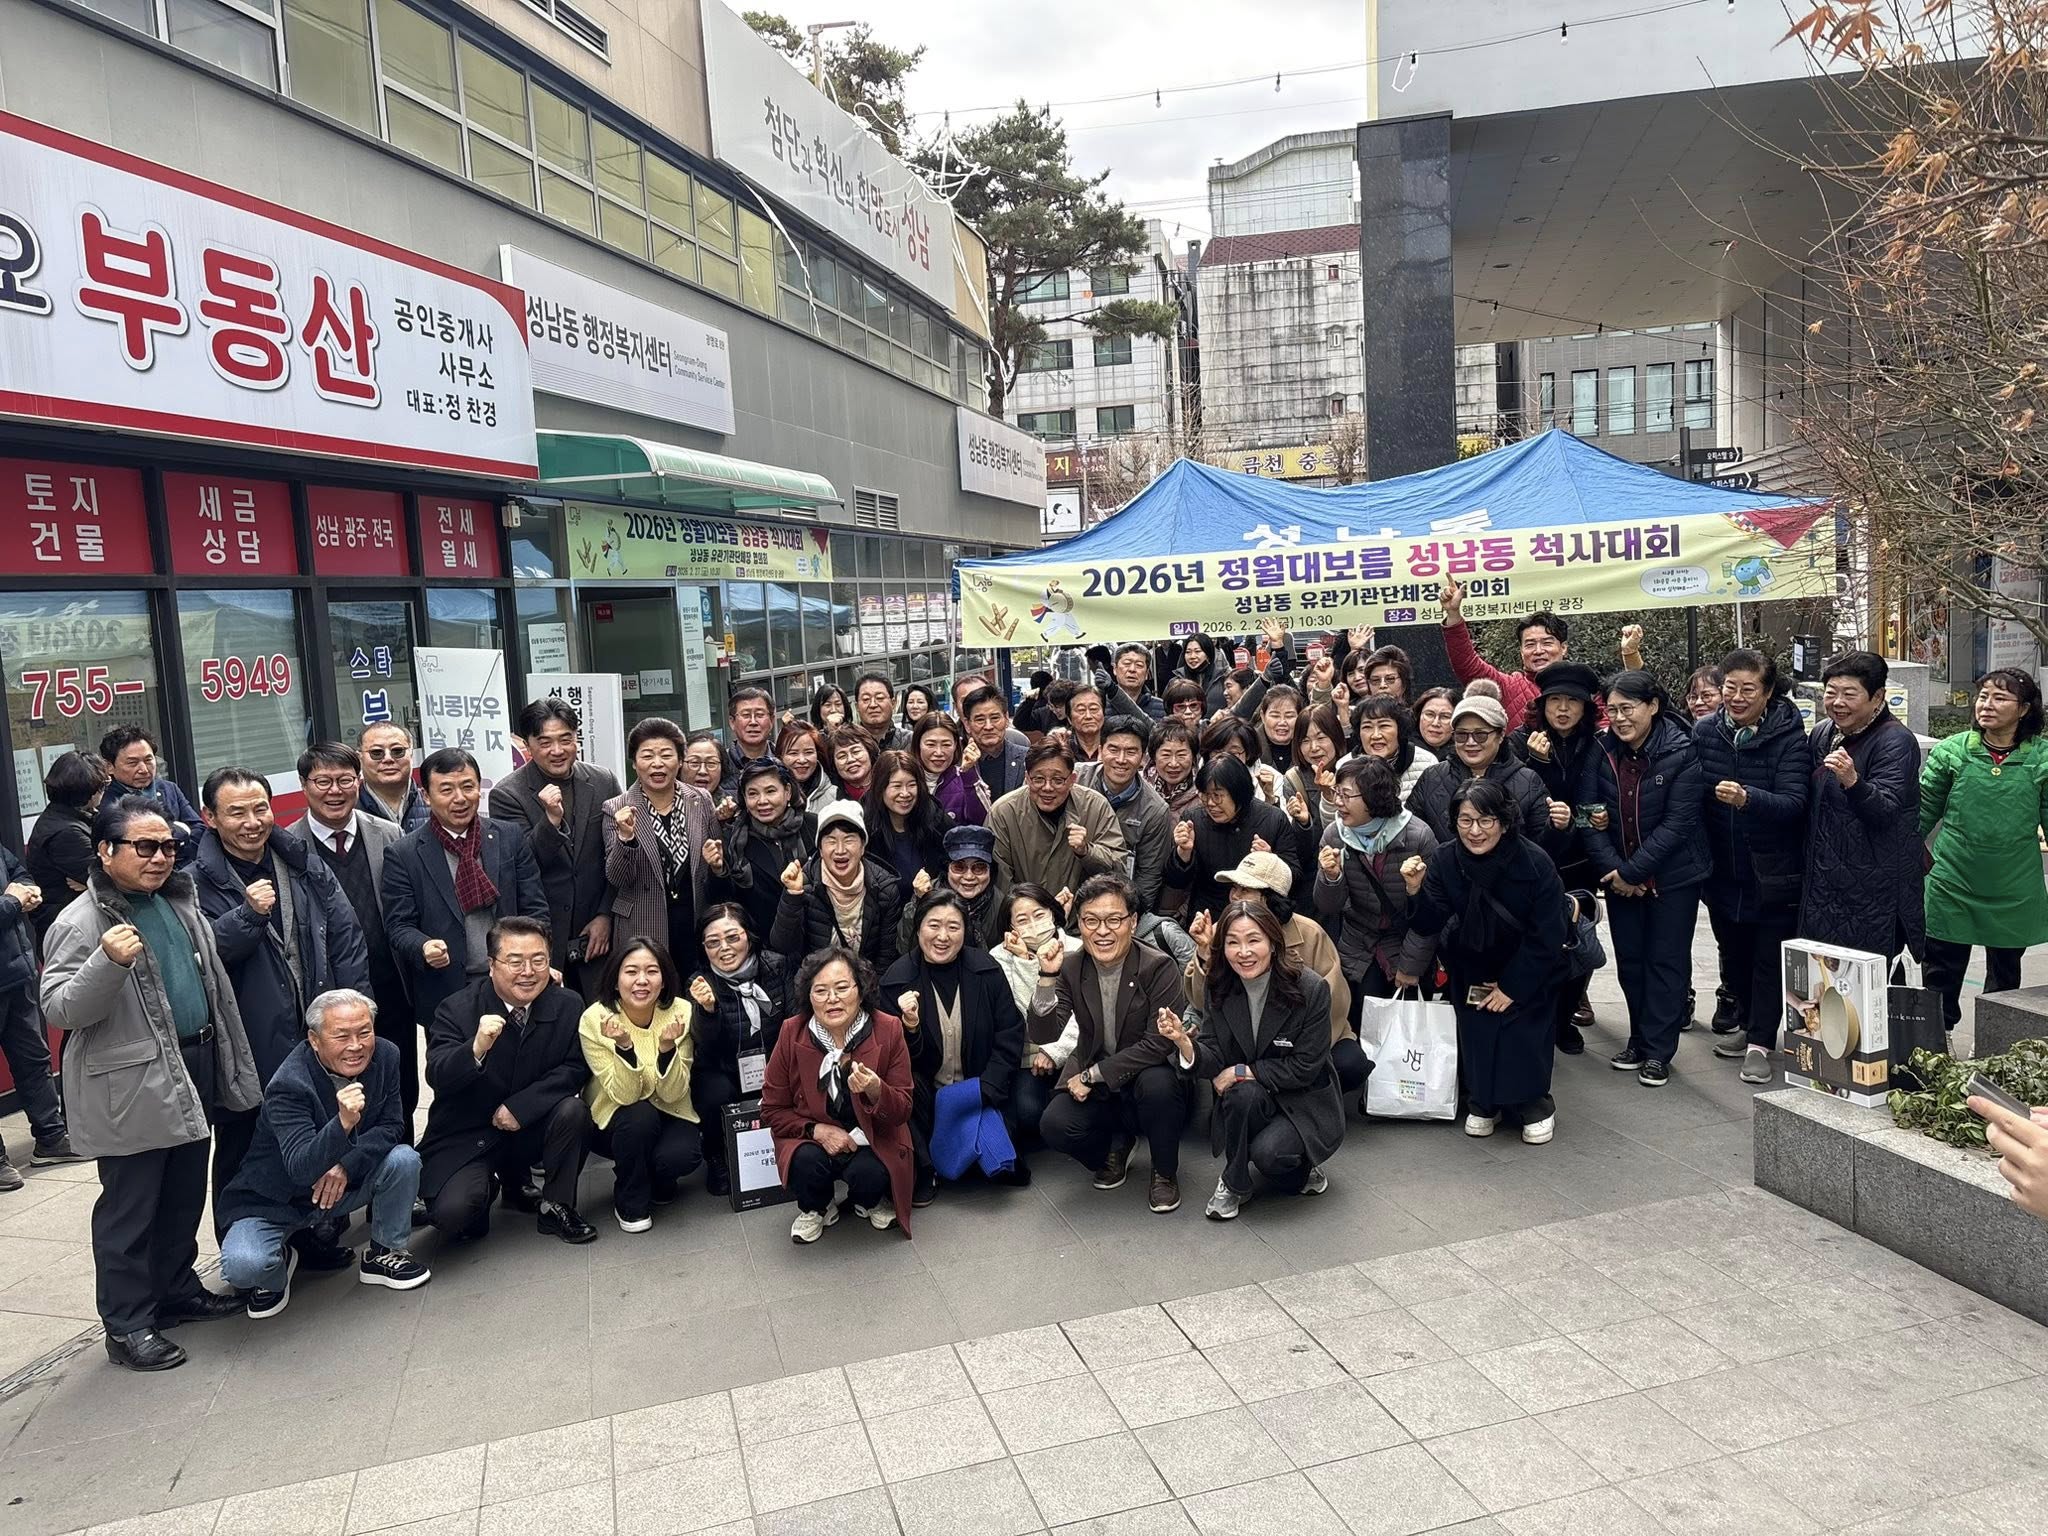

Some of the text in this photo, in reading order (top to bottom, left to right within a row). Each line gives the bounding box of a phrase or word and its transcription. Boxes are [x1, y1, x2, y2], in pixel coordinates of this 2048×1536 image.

[763, 96, 930, 272] 첨단과 혁신의 희망도시 성남
[75, 207, 380, 405] 부동산
[393, 297, 494, 355] 공인중개사
[526, 296, 673, 378] 성남동 행정복지센터
[439, 351, 495, 390] 사무소
[968, 432, 1023, 478] 성남동 행정복지센터
[623, 511, 803, 550] 2026년 정월대보름 성남동 척사대회
[689, 548, 709, 563] 성남동
[711, 549, 751, 565] 유관기관단체장
[1081, 523, 1682, 597] 2026년 정월대보름 성남동 척사대회
[1172, 622, 1198, 635] 일시
[1299, 614, 1333, 628] 10:30
[1387, 609, 1414, 622] 장소
[1461, 600, 1537, 617] 행정복지센터
[1541, 598, 1554, 611] 앞
[1558, 596, 1585, 611] 광장
[1234, 592, 1292, 615] 성남동
[1300, 582, 1442, 610] 유관기관단체장
[201, 653, 292, 703] 5949
[350, 645, 392, 679] 스타
